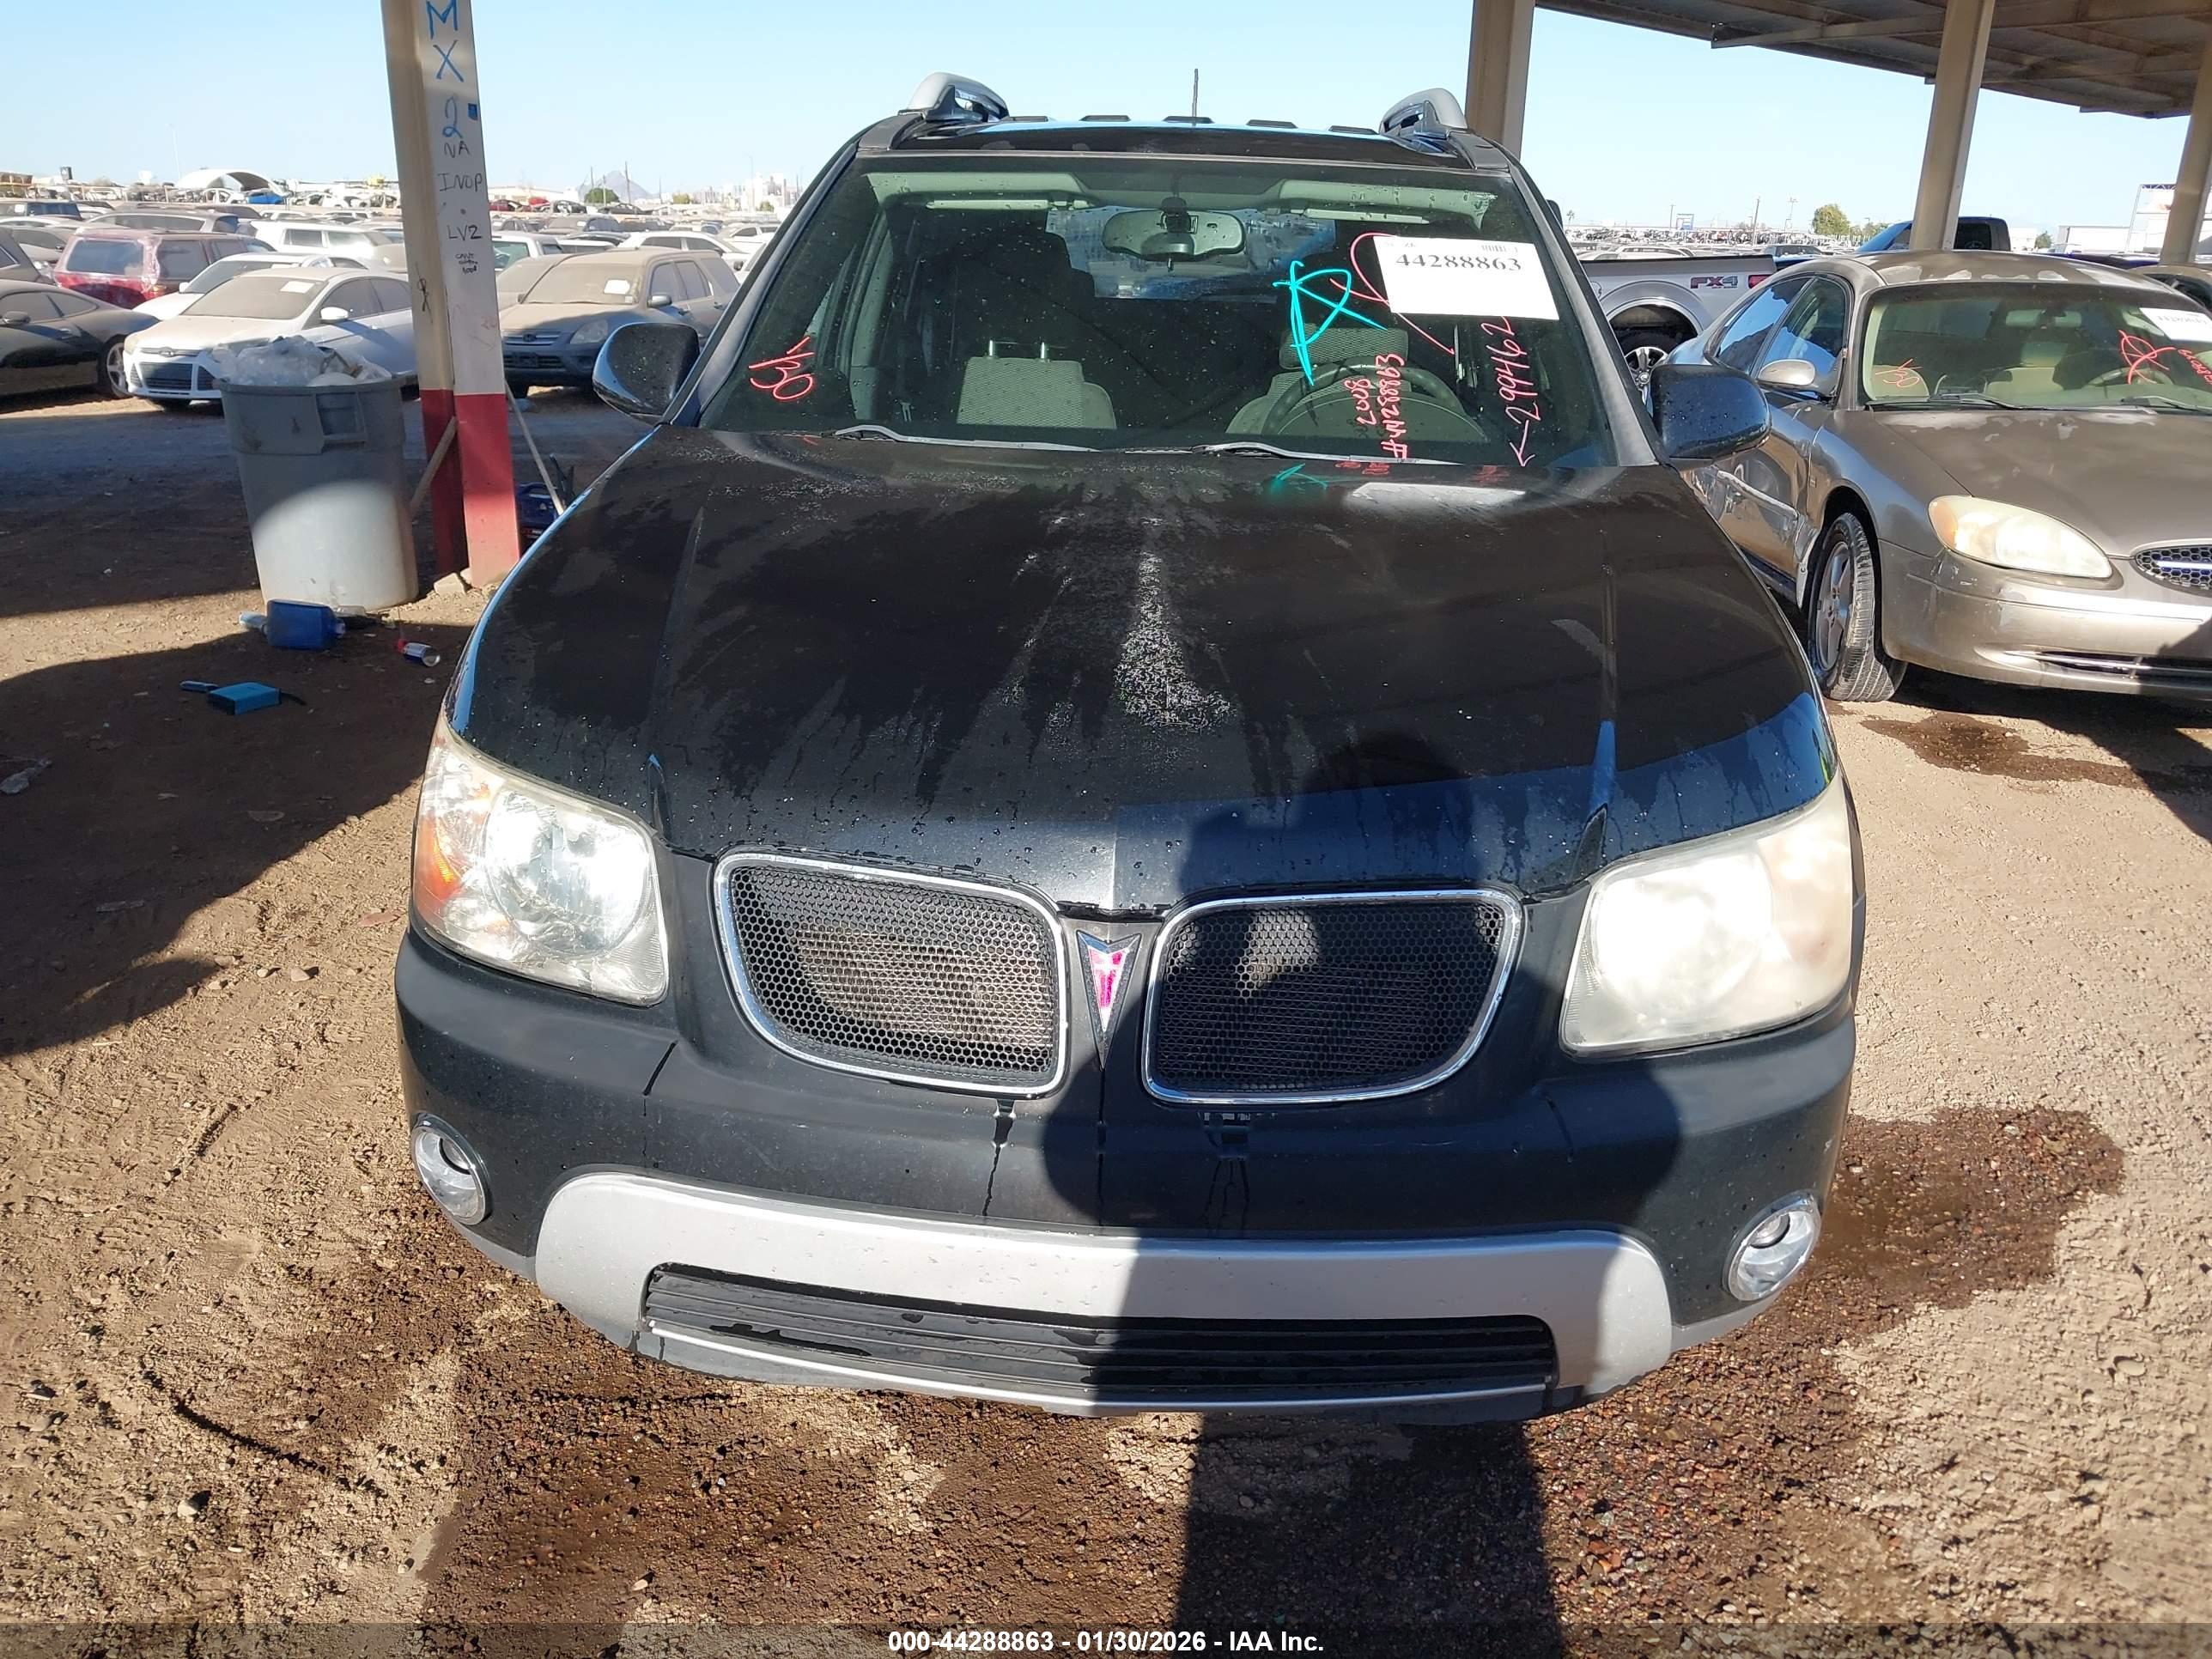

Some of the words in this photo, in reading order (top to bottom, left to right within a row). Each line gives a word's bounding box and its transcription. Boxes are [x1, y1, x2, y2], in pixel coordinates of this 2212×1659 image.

[444, 140, 470, 158] NA
[438, 173, 483, 192] INOP
[1395, 252, 1522, 272] 44288863
[1690, 275, 1739, 289] FX4
[1480, 316, 1542, 424] 299462
[1344, 378, 1377, 425] 2008
[1376, 353, 1408, 460] #44288863
